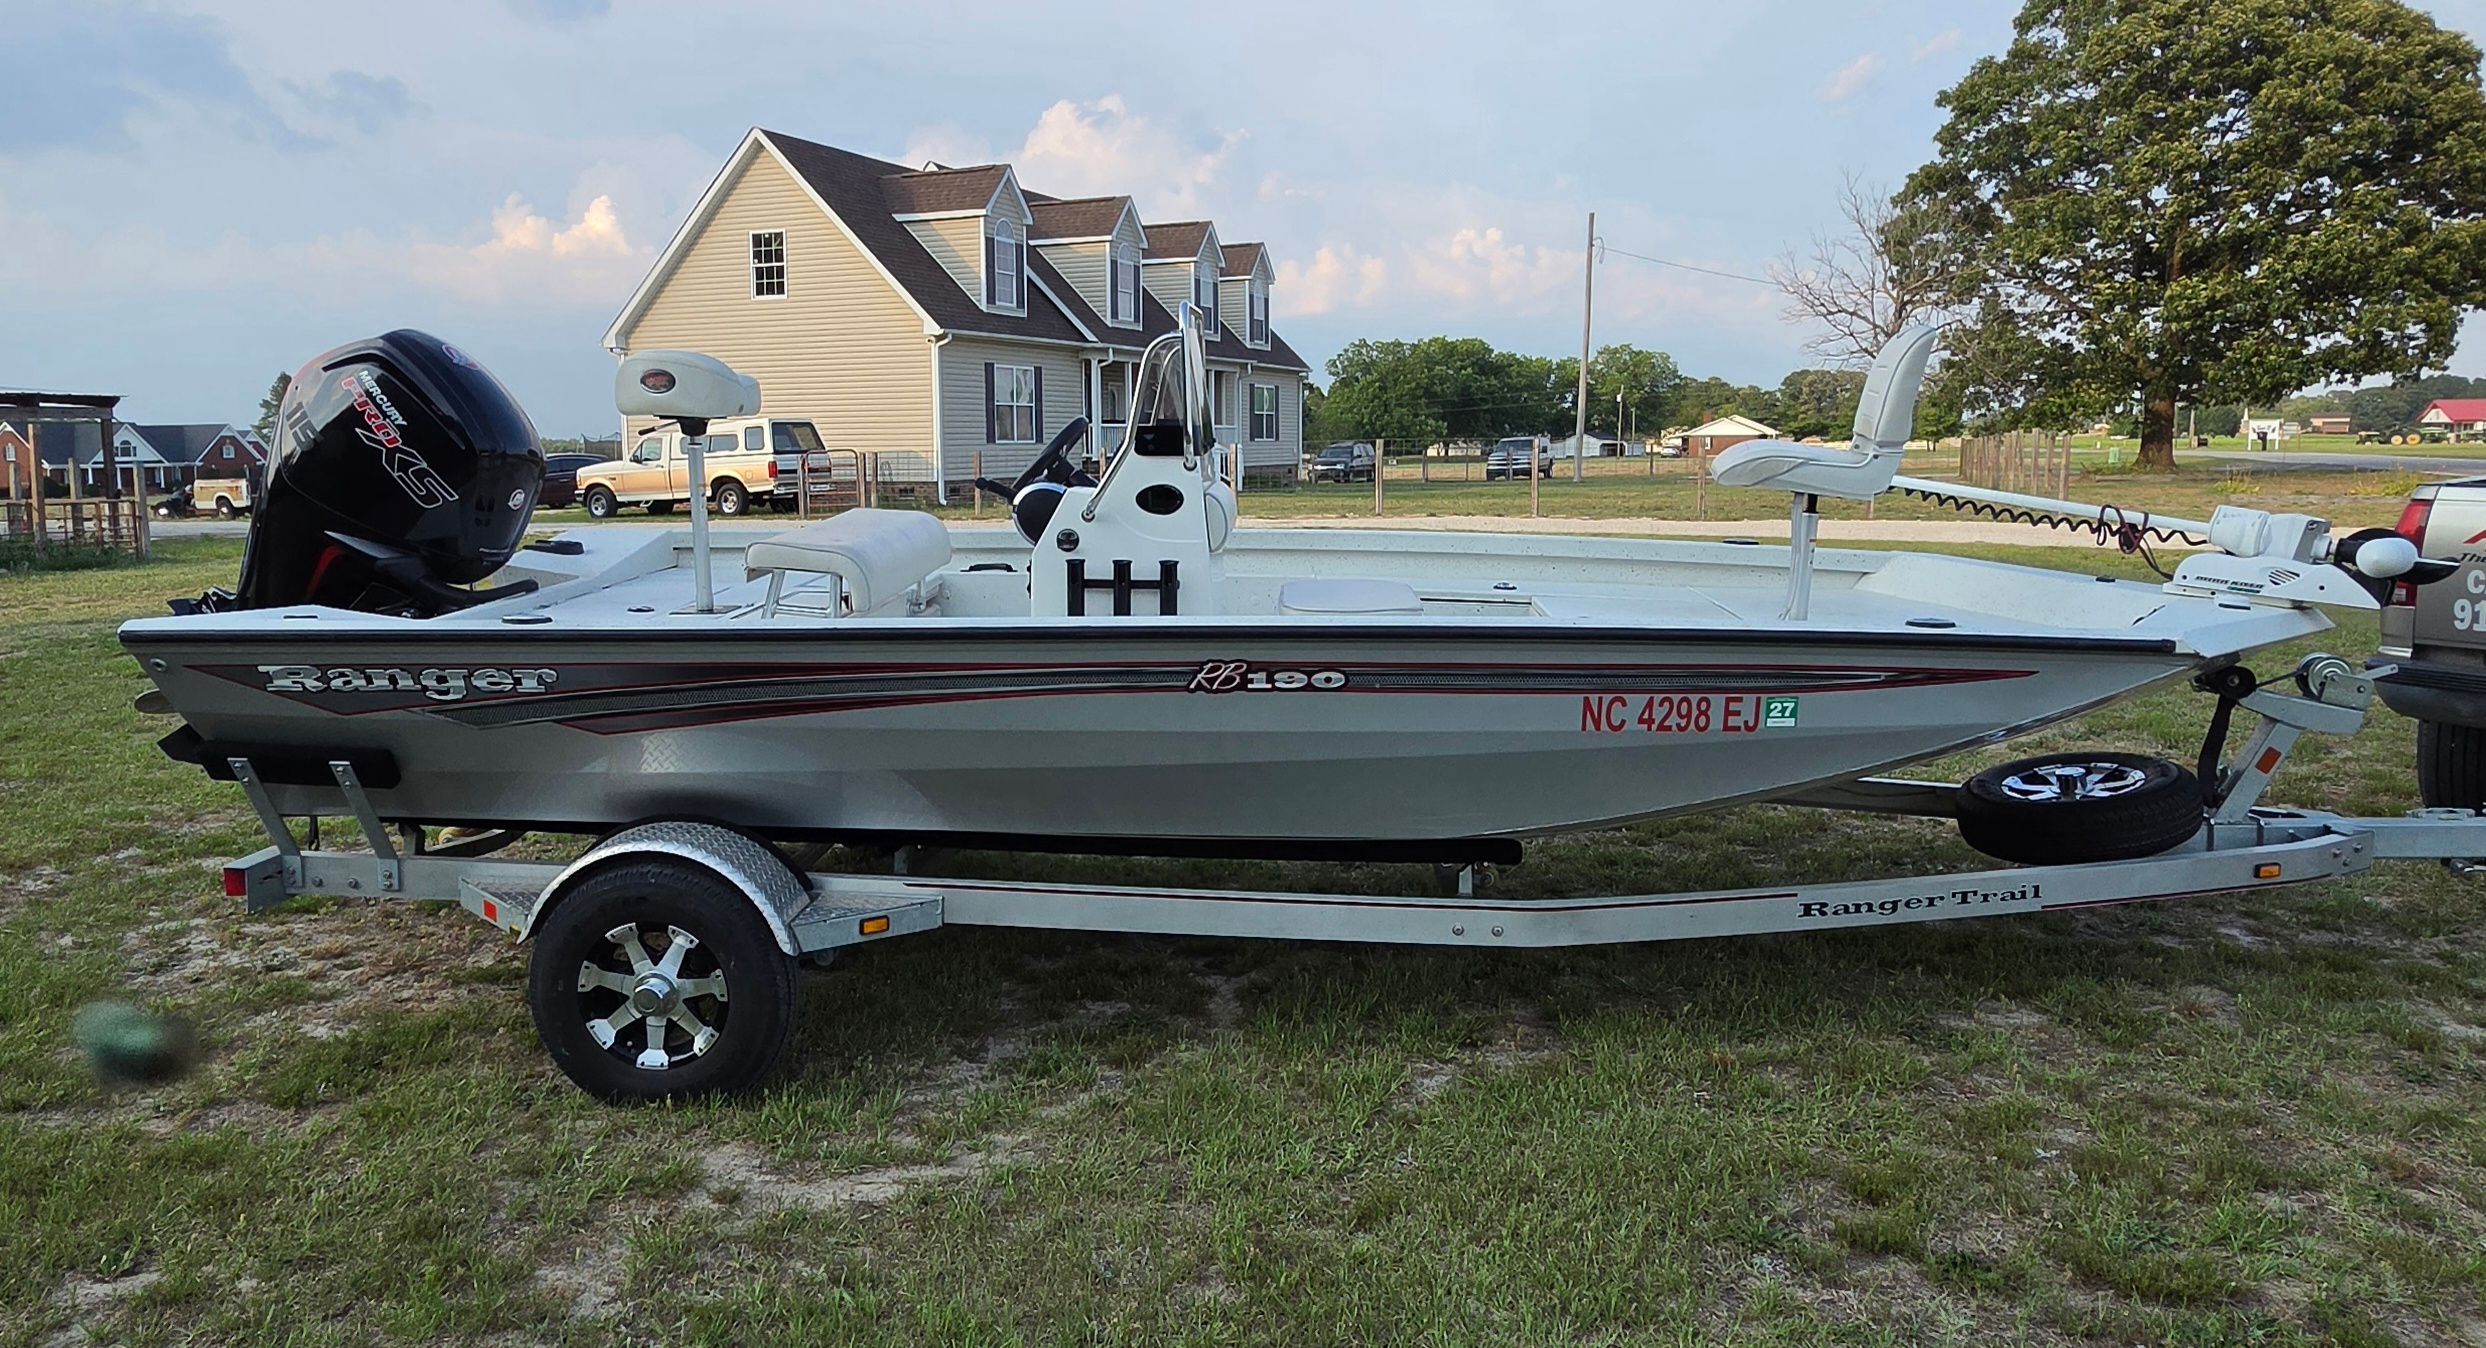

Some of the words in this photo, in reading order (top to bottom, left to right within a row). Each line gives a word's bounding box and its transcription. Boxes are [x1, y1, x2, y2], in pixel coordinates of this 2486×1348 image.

[341, 376, 402, 448] PRO
[359, 370, 408, 427] MERCURY
[285, 401, 324, 452] 115
[354, 427, 459, 509] XS
[2467, 569, 2486, 594] C
[257, 664, 558, 700] Ranger
[1189, 661, 1248, 690] RB
[1247, 671, 1345, 689] 190
[1580, 695, 1628, 733] NC
[1637, 695, 1712, 733] 4298
[1721, 695, 1762, 734] EJ
[1768, 702, 1795, 717] 27
[1797, 894, 1945, 918] Ranger
[1951, 884, 2043, 906] Trail
